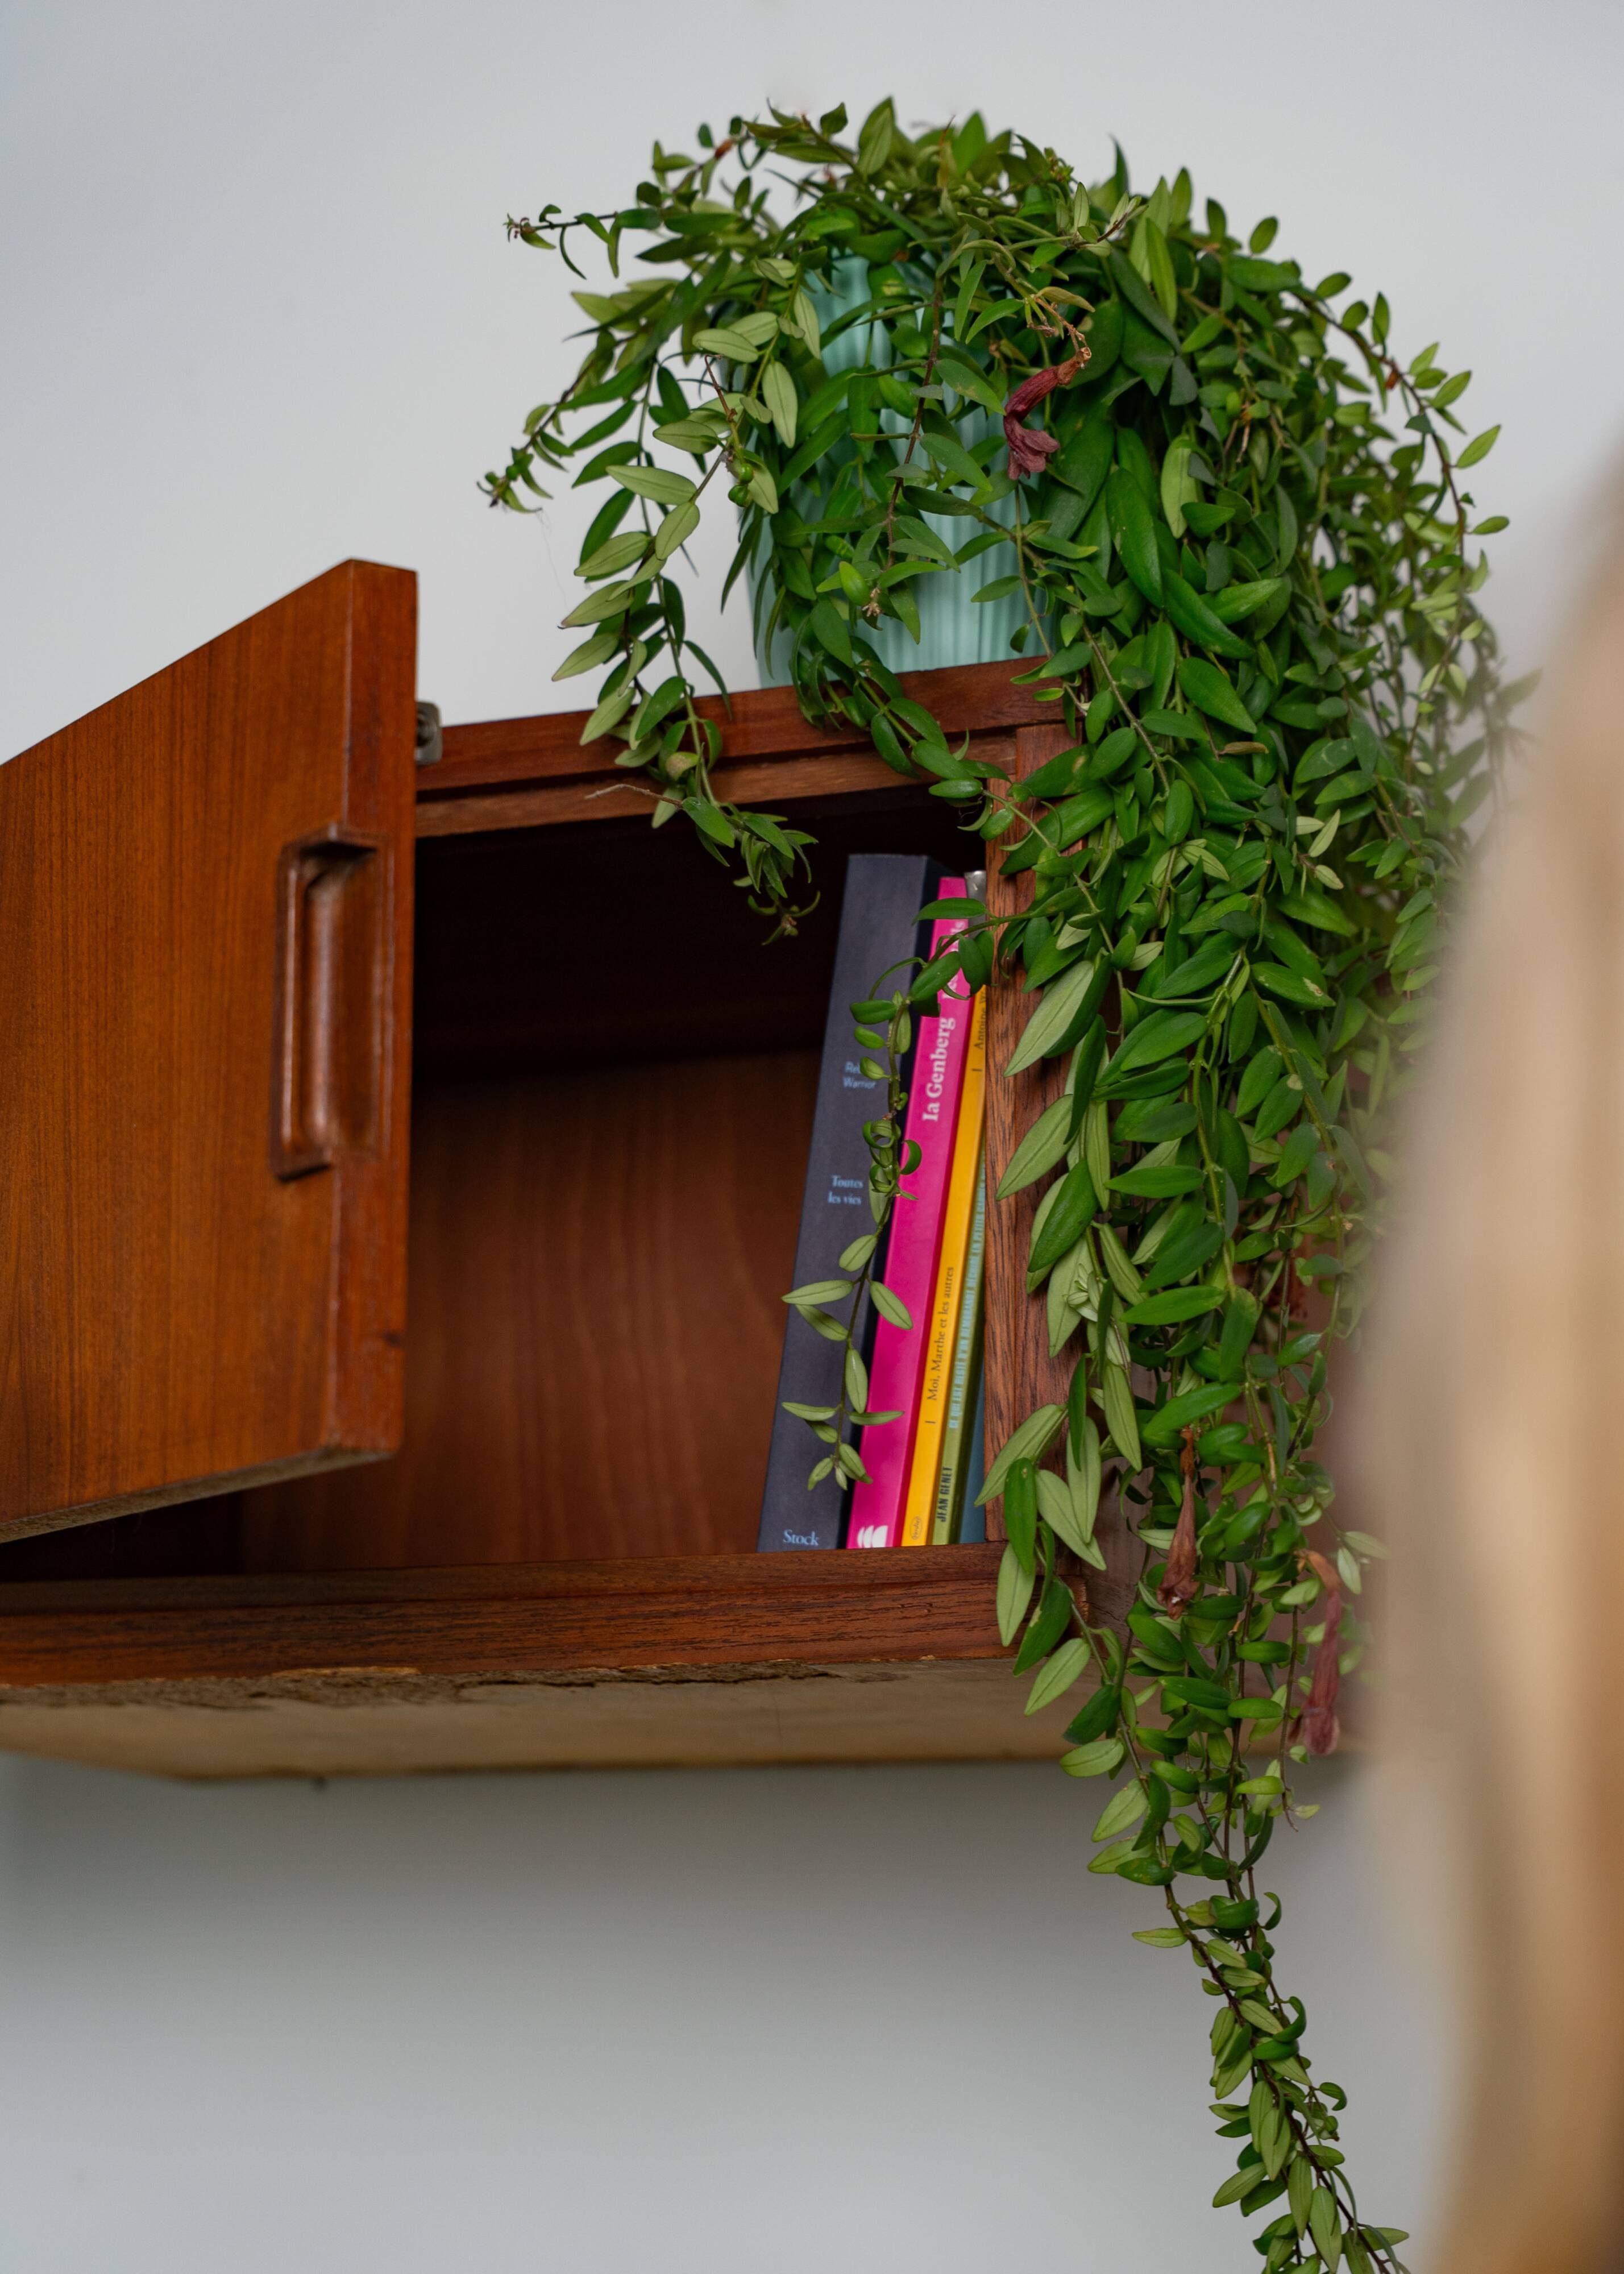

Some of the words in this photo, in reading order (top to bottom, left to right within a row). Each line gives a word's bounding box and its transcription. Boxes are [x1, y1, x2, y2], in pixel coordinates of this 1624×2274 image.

[925, 1017, 957, 1099] Genberg
[832, 1175, 863, 1188] Toutes
[828, 1190, 841, 1204] les
[843, 1193, 862, 1205] vies
[944, 1267, 954, 1298] autres
[937, 1301, 950, 1315] les
[940, 1318, 948, 1329] et
[930, 1331, 946, 1371] Marthe
[927, 1375, 940, 1401] Moi,
[940, 1467, 953, 1495] GENET
[936, 1498, 949, 1522] JEAN
[783, 1529, 820, 1546] Stock
